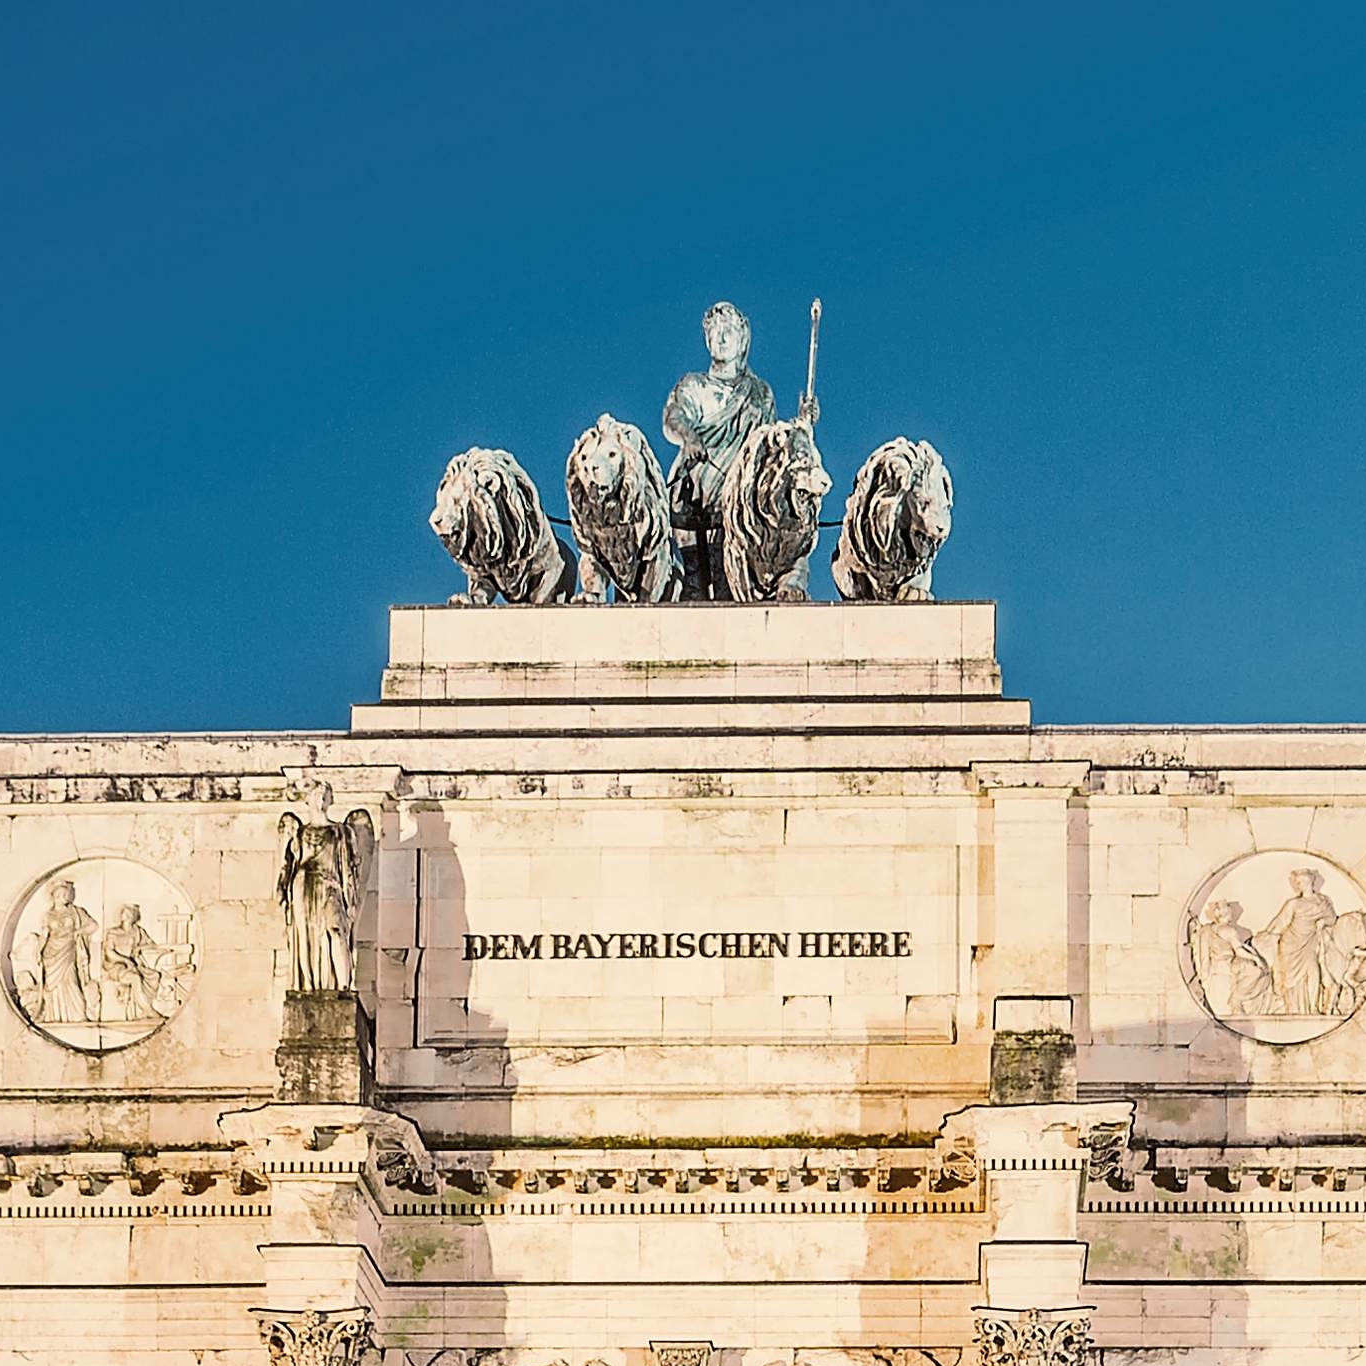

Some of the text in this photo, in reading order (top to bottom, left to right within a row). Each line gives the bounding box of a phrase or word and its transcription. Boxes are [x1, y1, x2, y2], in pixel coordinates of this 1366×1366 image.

[462, 932, 913, 960] DEM BAYERISCHEN HEERE
